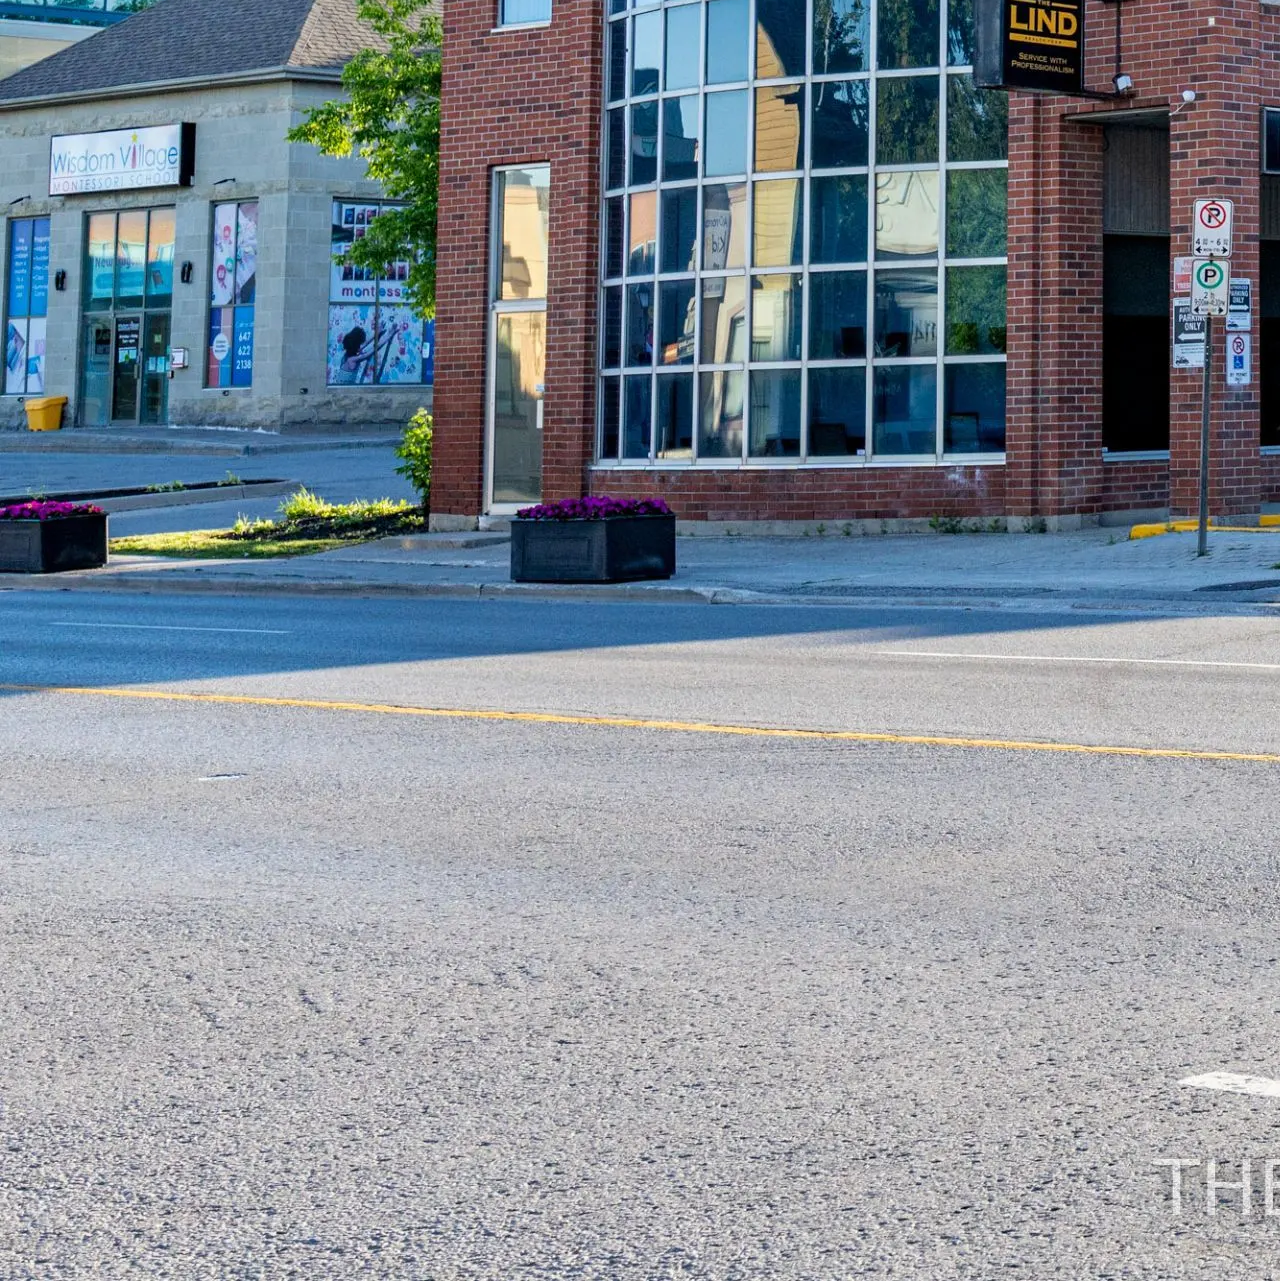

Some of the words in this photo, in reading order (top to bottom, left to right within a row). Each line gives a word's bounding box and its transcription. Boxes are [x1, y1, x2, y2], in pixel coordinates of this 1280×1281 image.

[1010, 4, 1078, 36] LIND
[1019, 52, 1048, 63] SERVICE
[1050, 56, 1068, 65] WITH
[1011, 59, 1075, 74] PROFESSIONALISM
[53, 149, 115, 174] Wisdom
[119, 143, 178, 170] Village
[53, 177, 124, 193] MONTESSORI
[130, 170, 178, 186] SCHOOL
[1184, 322, 1201, 331] ONLY
[238, 332, 251, 342] 647
